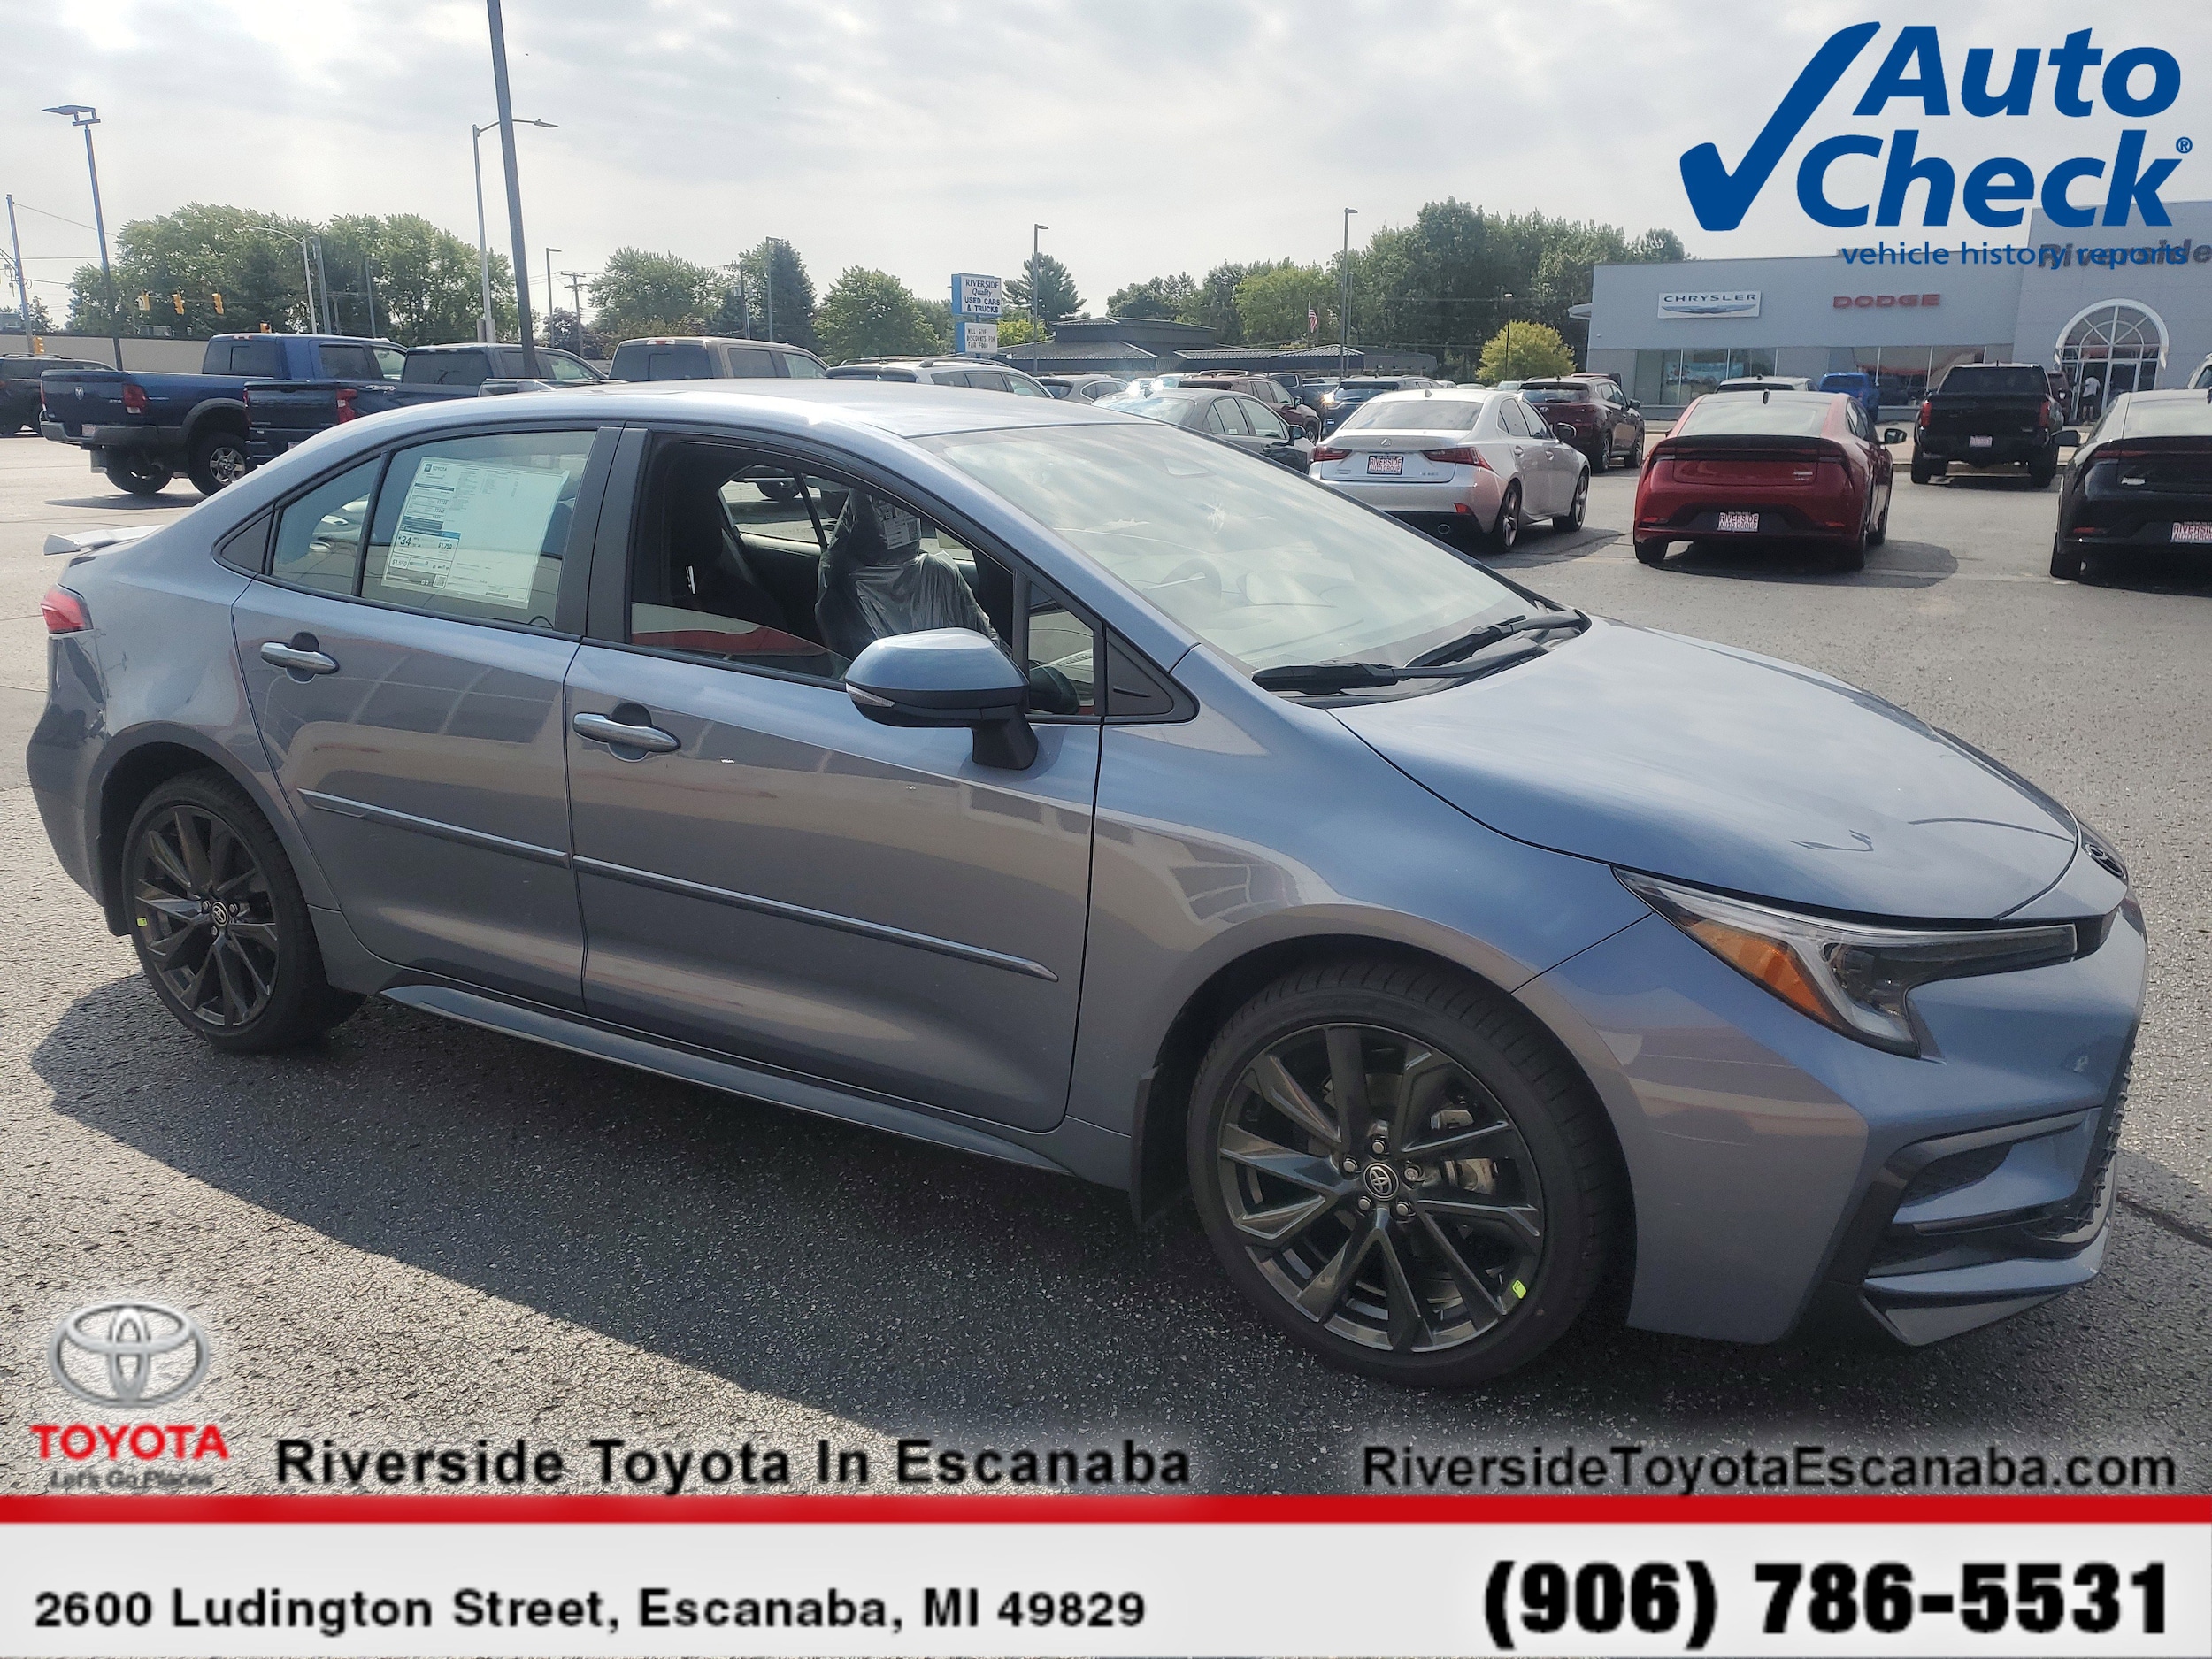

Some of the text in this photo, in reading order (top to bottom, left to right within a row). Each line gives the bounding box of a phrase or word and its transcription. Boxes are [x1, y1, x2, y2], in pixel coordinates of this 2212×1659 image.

[965, 279, 999, 289] RIVERSIDE
[1663, 294, 1757, 303] CHRYSLER
[1832, 294, 1941, 309] DODGE
[1369, 457, 1402, 466] RIVERSIDE
[1719, 513, 1759, 523] RIVERSIDE
[2173, 523, 2212, 533] RIVERSI
[400, 535, 412, 546] 34
